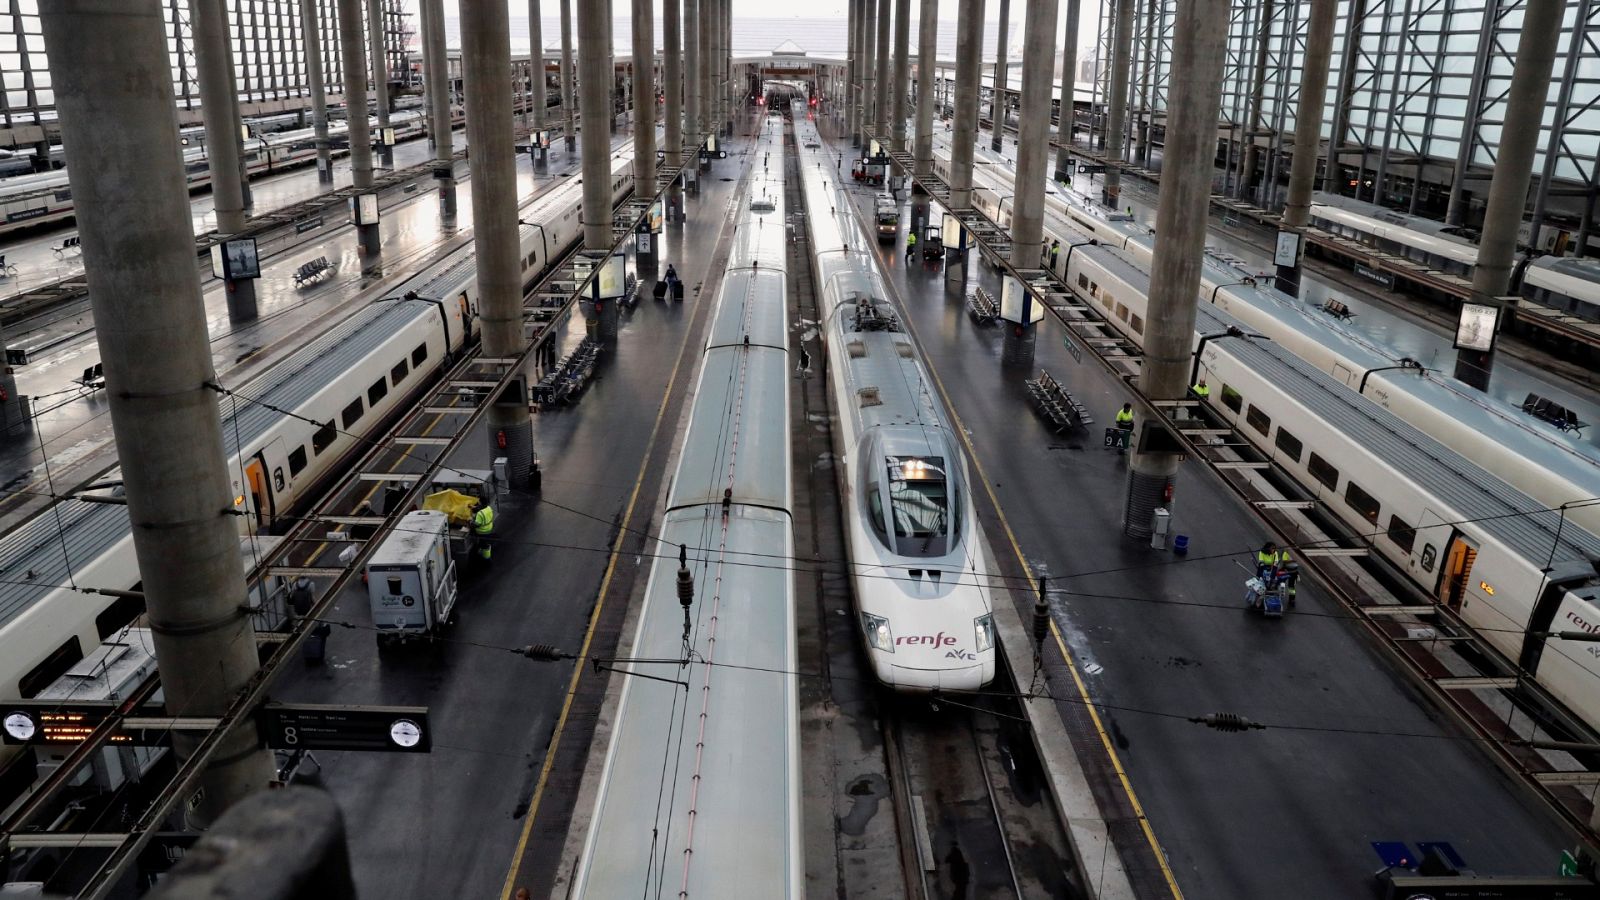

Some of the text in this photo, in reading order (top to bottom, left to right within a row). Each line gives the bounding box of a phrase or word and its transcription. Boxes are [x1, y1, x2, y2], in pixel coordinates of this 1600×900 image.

[1106, 437, 1123, 447] 9 A
[895, 631, 957, 649] renfe
[284, 726, 298, 744] 8
